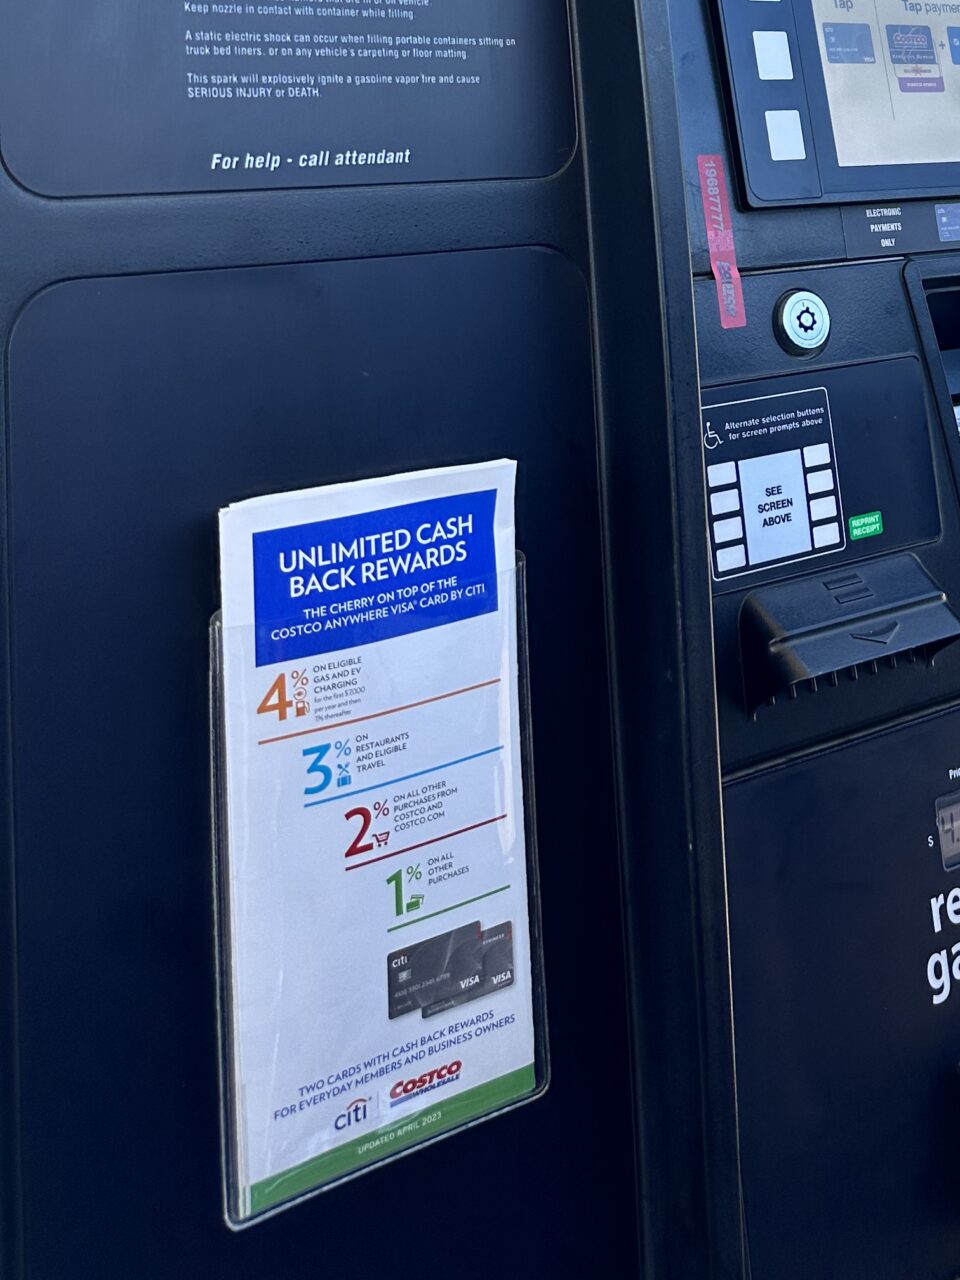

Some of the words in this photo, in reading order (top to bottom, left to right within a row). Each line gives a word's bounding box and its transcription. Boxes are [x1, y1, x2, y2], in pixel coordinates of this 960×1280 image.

[187, 87, 232, 98] SERIOUS
[236, 87, 272, 98] INJURY
[275, 89, 284, 97] or
[211, 153, 239, 169] For
[244, 152, 280, 171] help
[298, 150, 329, 167] call
[334, 148, 410, 165] attendant
[865, 207, 902, 218] ELECTRONIC
[870, 222, 902, 232] PAYMENTS
[880, 237, 896, 248] ONLY
[724, 418, 760, 430] Alternate
[761, 412, 795, 424] selection
[796, 407, 824, 417] buttons
[728, 432, 740, 440] for
[741, 427, 768, 438] screen
[769, 421, 800, 434] prompts
[801, 417, 822, 427] above
[765, 485, 782, 497] SEE
[757, 497, 793, 514] SCREEN
[762, 512, 793, 528] ABOVE
[851, 515, 881, 527] REPRINT
[853, 523, 881, 536] RECEIPT
[279, 529, 411, 573] UNLIMITED
[416, 514, 473, 545] CASH
[289, 565, 357, 599] BACK
[361, 541, 467, 584] REWARDS
[303, 605, 327, 619] THE
[329, 595, 375, 615] CHERRY
[376, 591, 395, 605] ON
[396, 585, 419, 600] TOP
[420, 581, 436, 594] OF
[437, 575, 458, 590] THE
[271, 621, 321, 640] COSTCO
[324, 607, 389, 631] ANYWHERE
[420, 592, 449, 609] CARD
[450, 588, 464, 602] BY
[465, 583, 486, 597] CITI
[298, 1080, 325, 1096] TWO
[327, 1064, 362, 1086] CARDS
[364, 1052, 390, 1069] WITH
[392, 1040, 418, 1058] CASH
[420, 1029, 446, 1046] BACK
[448, 1010, 495, 1036] REWARDS
[389, 1059, 463, 1099] COSTCO
[412, 1074, 460, 1098] WHOLESALE
[334, 1100, 368, 1130] citi
[357, 1131, 395, 1155] UPDATED
[396, 1121, 420, 1137] APRIL
[421, 1111, 443, 1127] 2023
